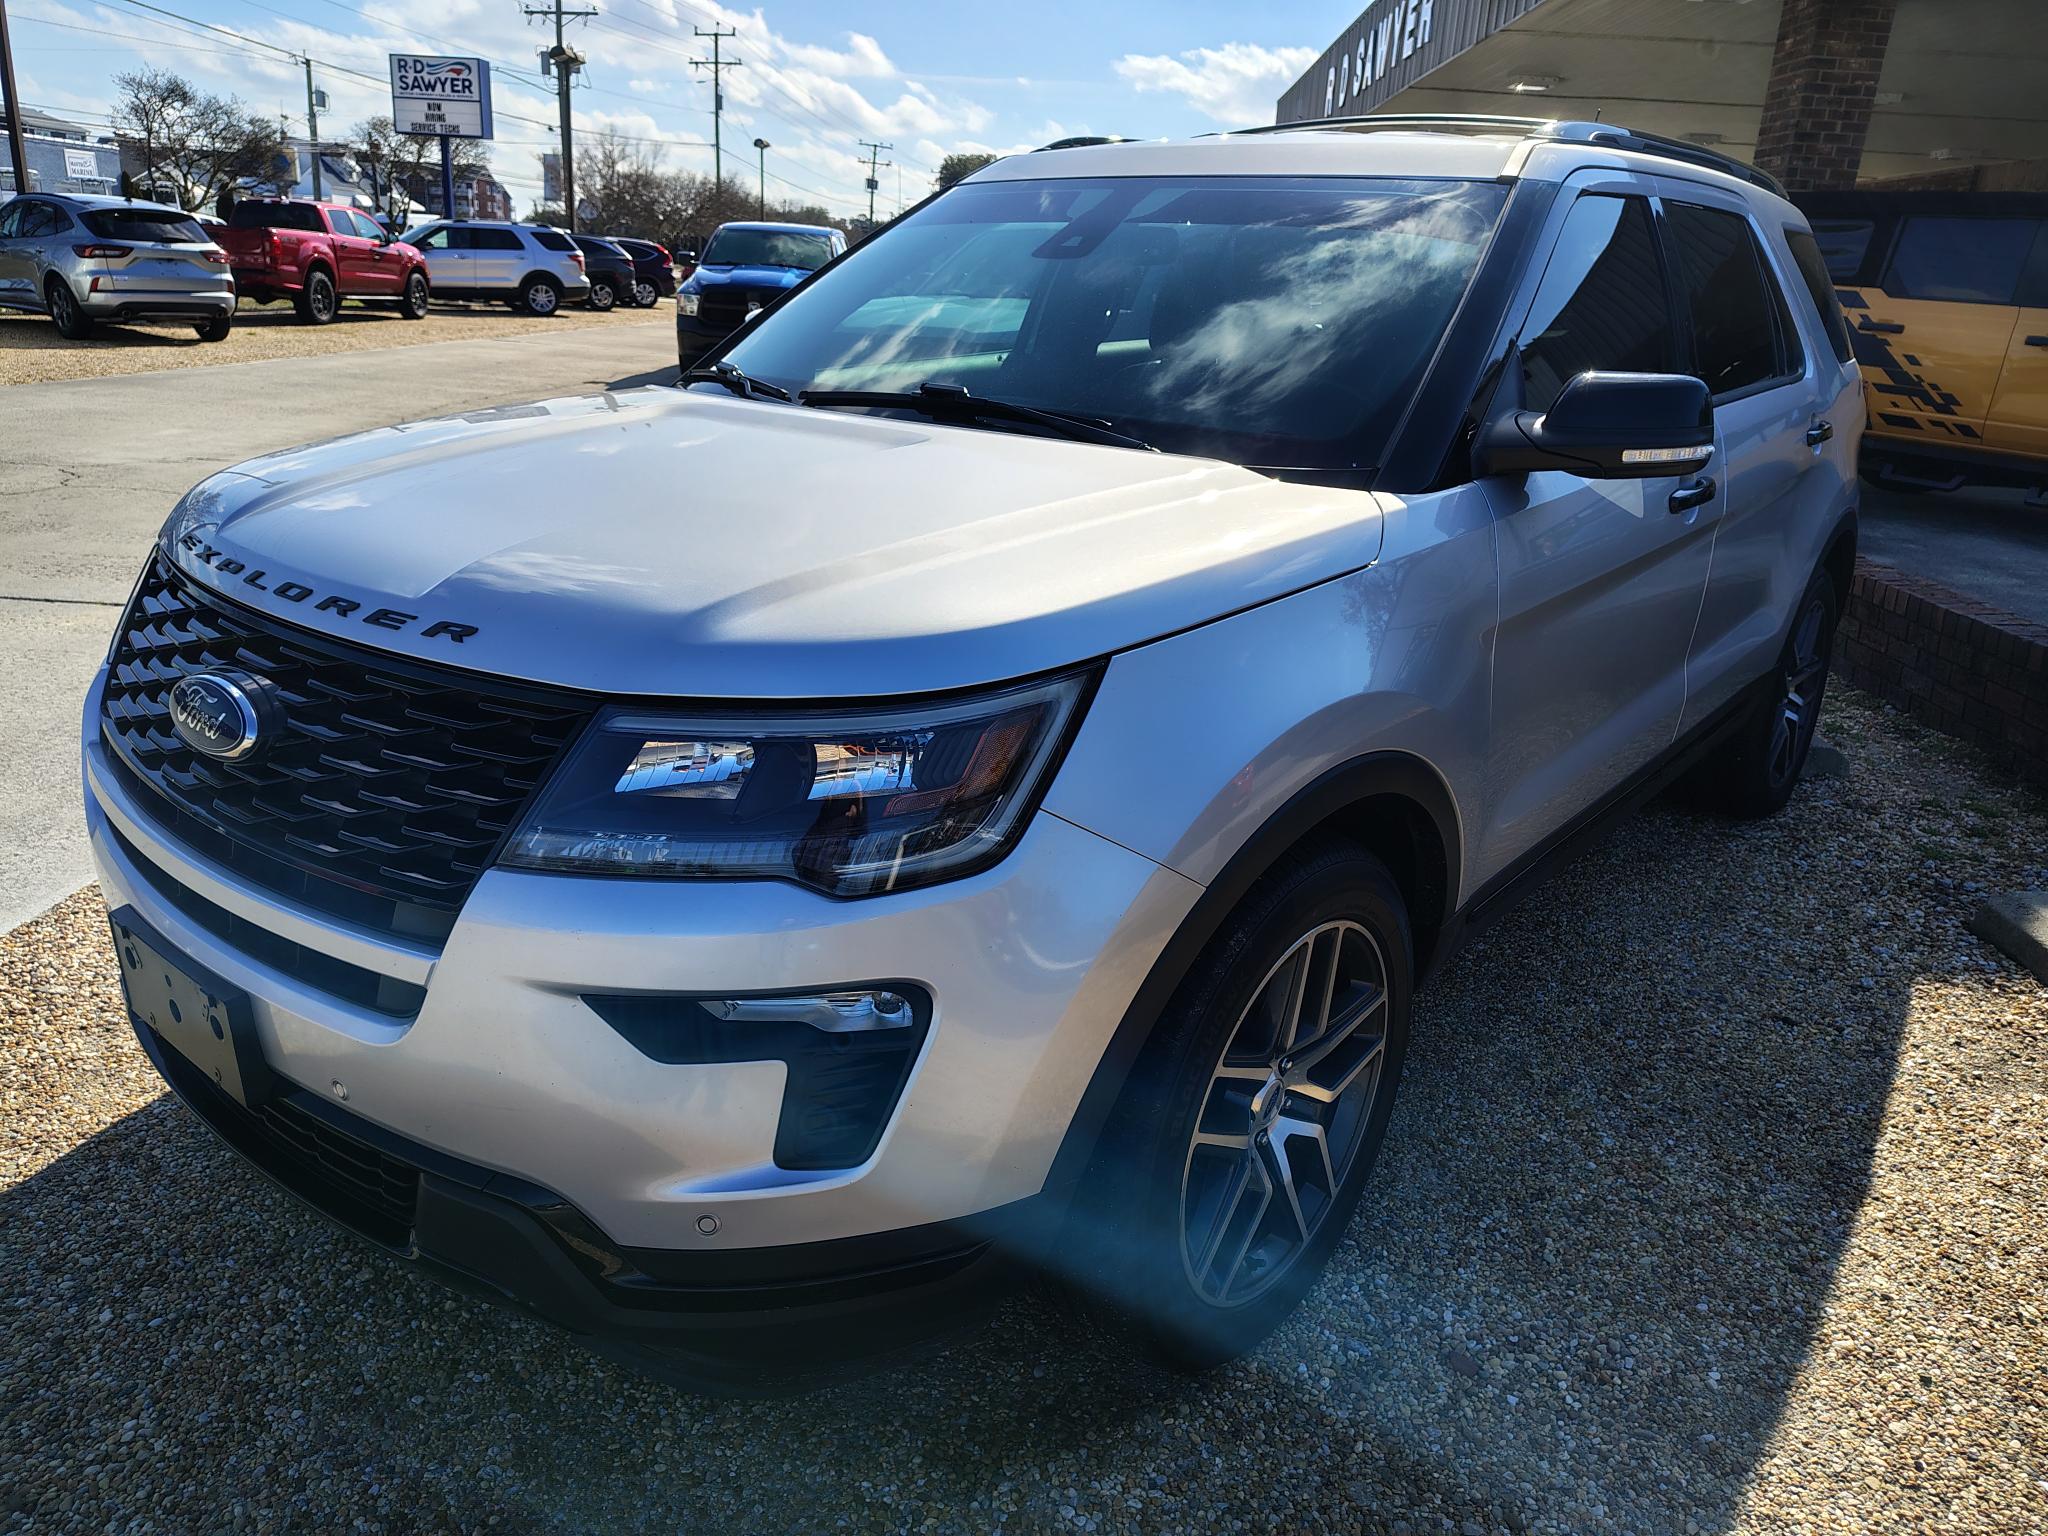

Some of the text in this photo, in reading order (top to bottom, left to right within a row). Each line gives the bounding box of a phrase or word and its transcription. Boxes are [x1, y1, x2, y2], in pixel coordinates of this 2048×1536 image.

[399, 75, 473, 94] SAWYER
[1323, 66, 1336, 118] R
[1338, 53, 1349, 108] D
[180, 534, 479, 643] EXPLORER
[175, 684, 226, 740] Ford
